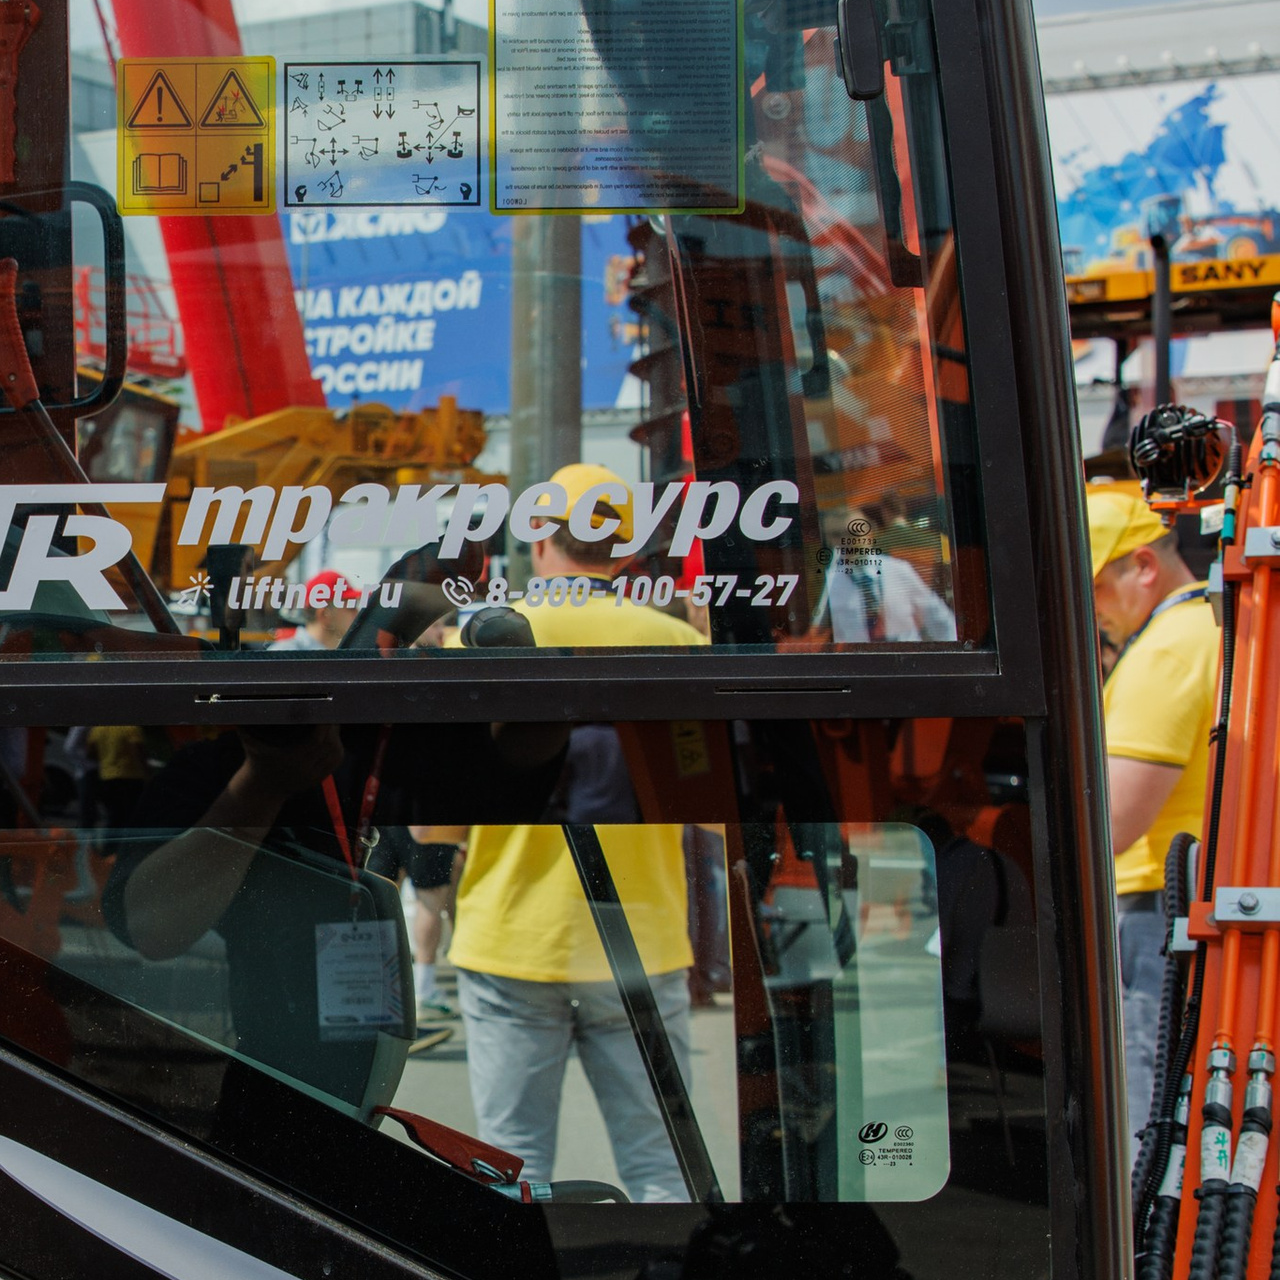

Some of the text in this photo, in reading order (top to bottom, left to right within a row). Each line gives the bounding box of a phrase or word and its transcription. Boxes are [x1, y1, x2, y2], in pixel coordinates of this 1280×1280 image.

[1180, 261, 1267, 285] SANY
[337, 270, 483, 318] КАЖДОЙ
[311, 359, 423, 395] ОССИИ
[836, 547, 883, 556] TEMPERED
[226, 573, 404, 611] liftnet.ru
[485, 573, 799, 608] 8-800-100-57-27
